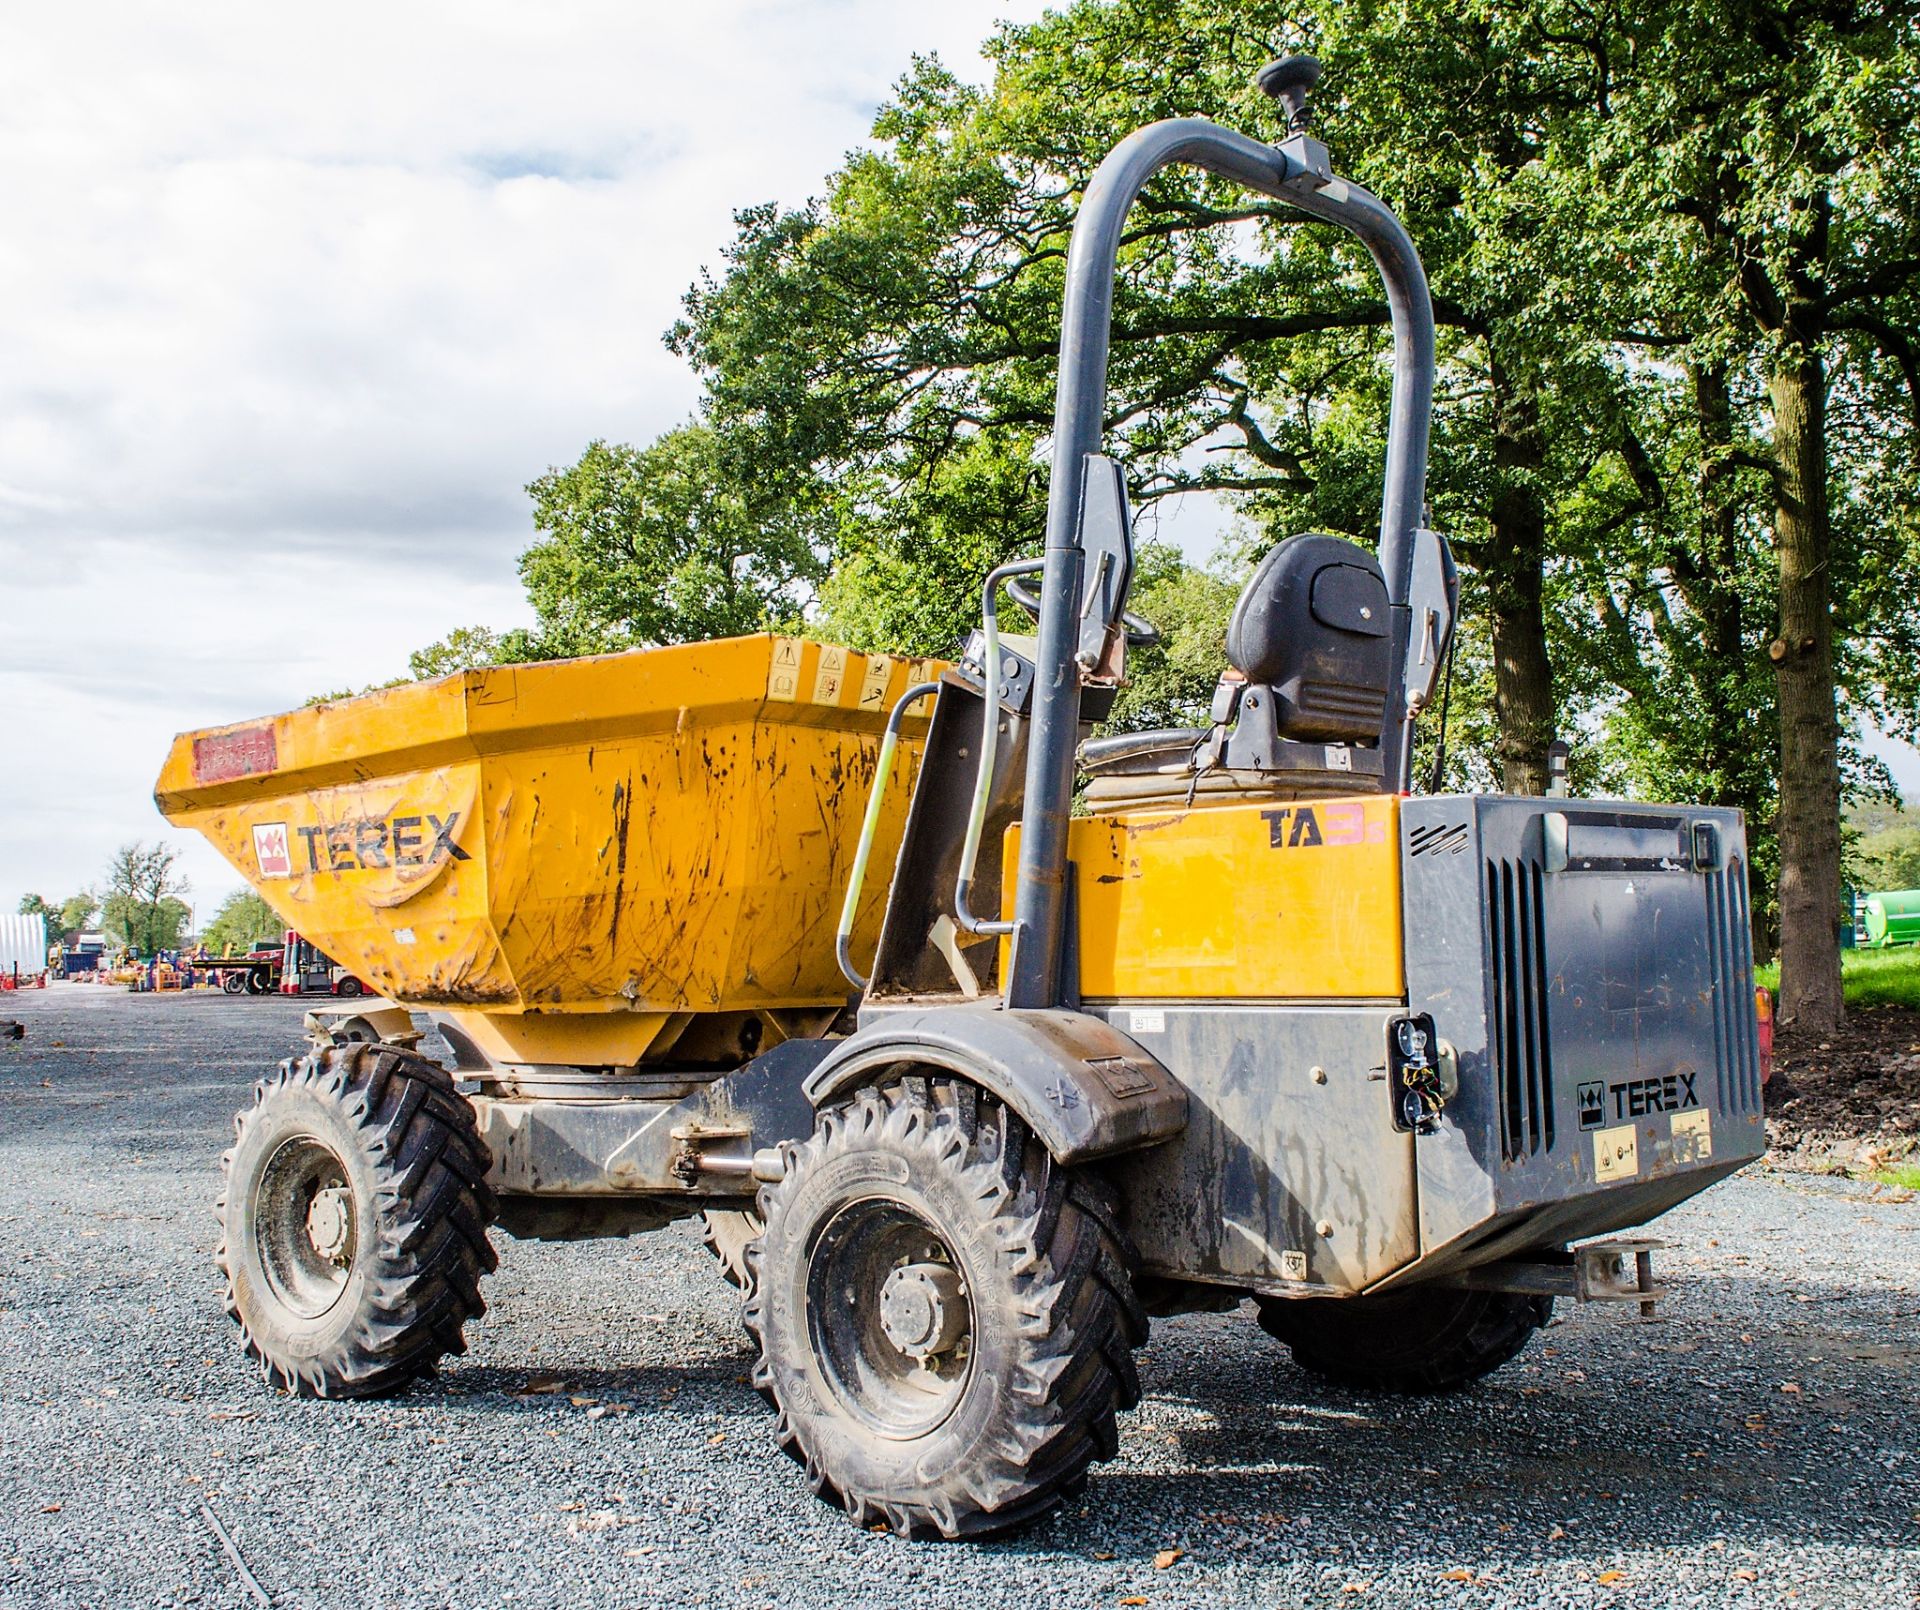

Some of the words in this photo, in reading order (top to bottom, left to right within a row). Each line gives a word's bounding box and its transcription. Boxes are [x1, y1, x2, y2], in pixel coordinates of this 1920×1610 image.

[297, 812, 472, 872] TEREX
[1610, 1072, 1699, 1119] TEREX
[955, 1217, 1001, 1347] DUMPER
